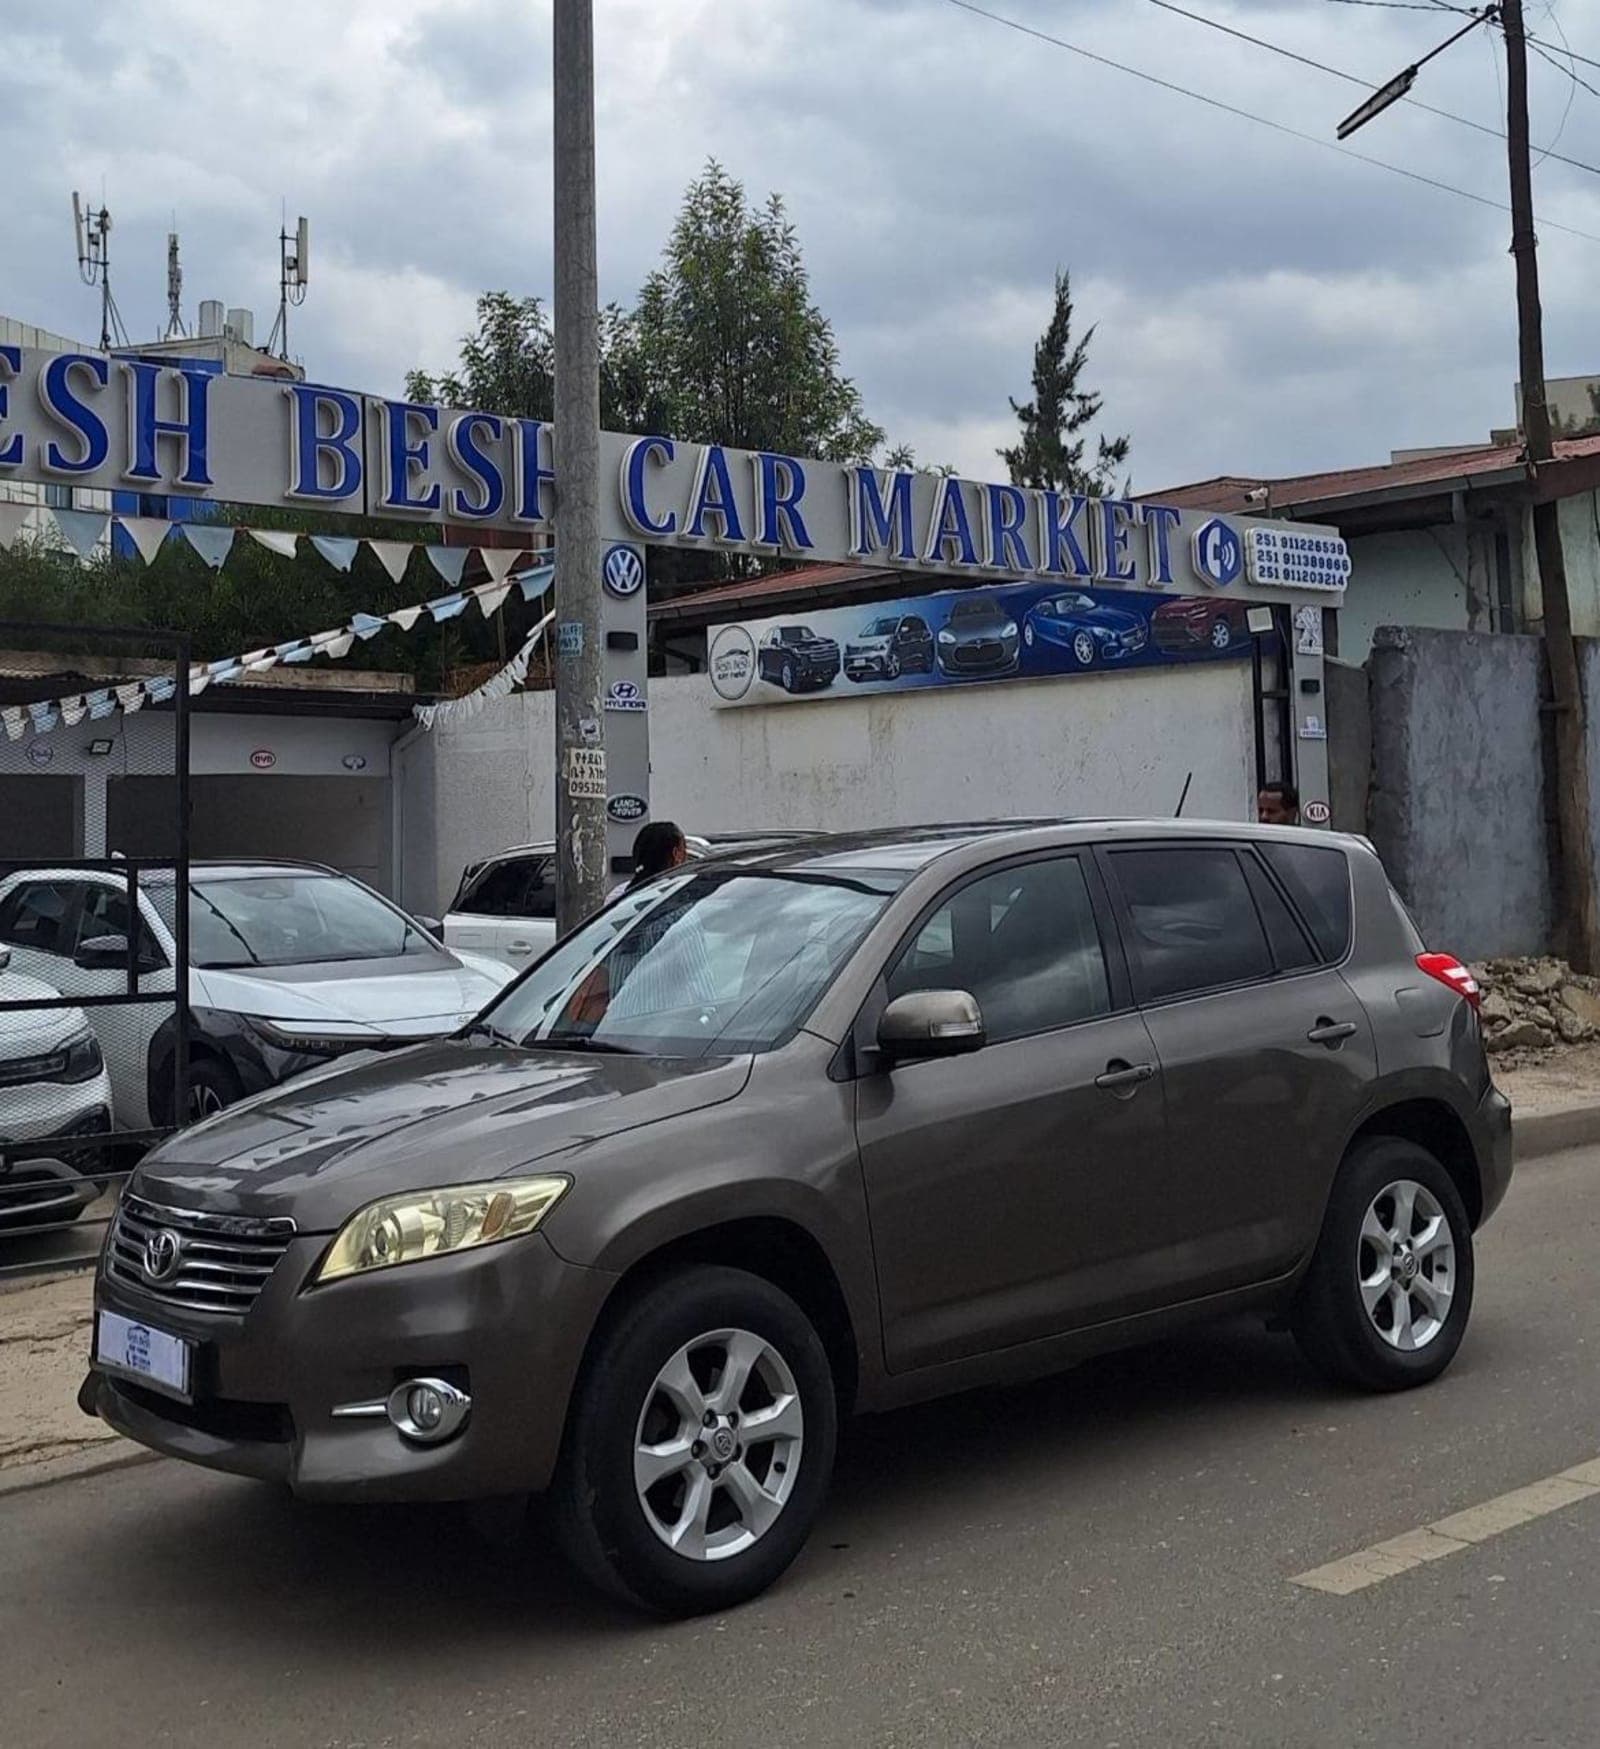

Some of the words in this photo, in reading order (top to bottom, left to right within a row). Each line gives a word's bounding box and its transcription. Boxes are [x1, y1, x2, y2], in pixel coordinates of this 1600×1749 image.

[619, 434, 816, 549] CAR
[843, 466, 1181, 588] MARKET
[1256, 533, 1277, 547] 251
[1257, 549, 1278, 563] 251
[1259, 565, 1280, 579] 251
[1308, 807, 1326, 817] KIA
